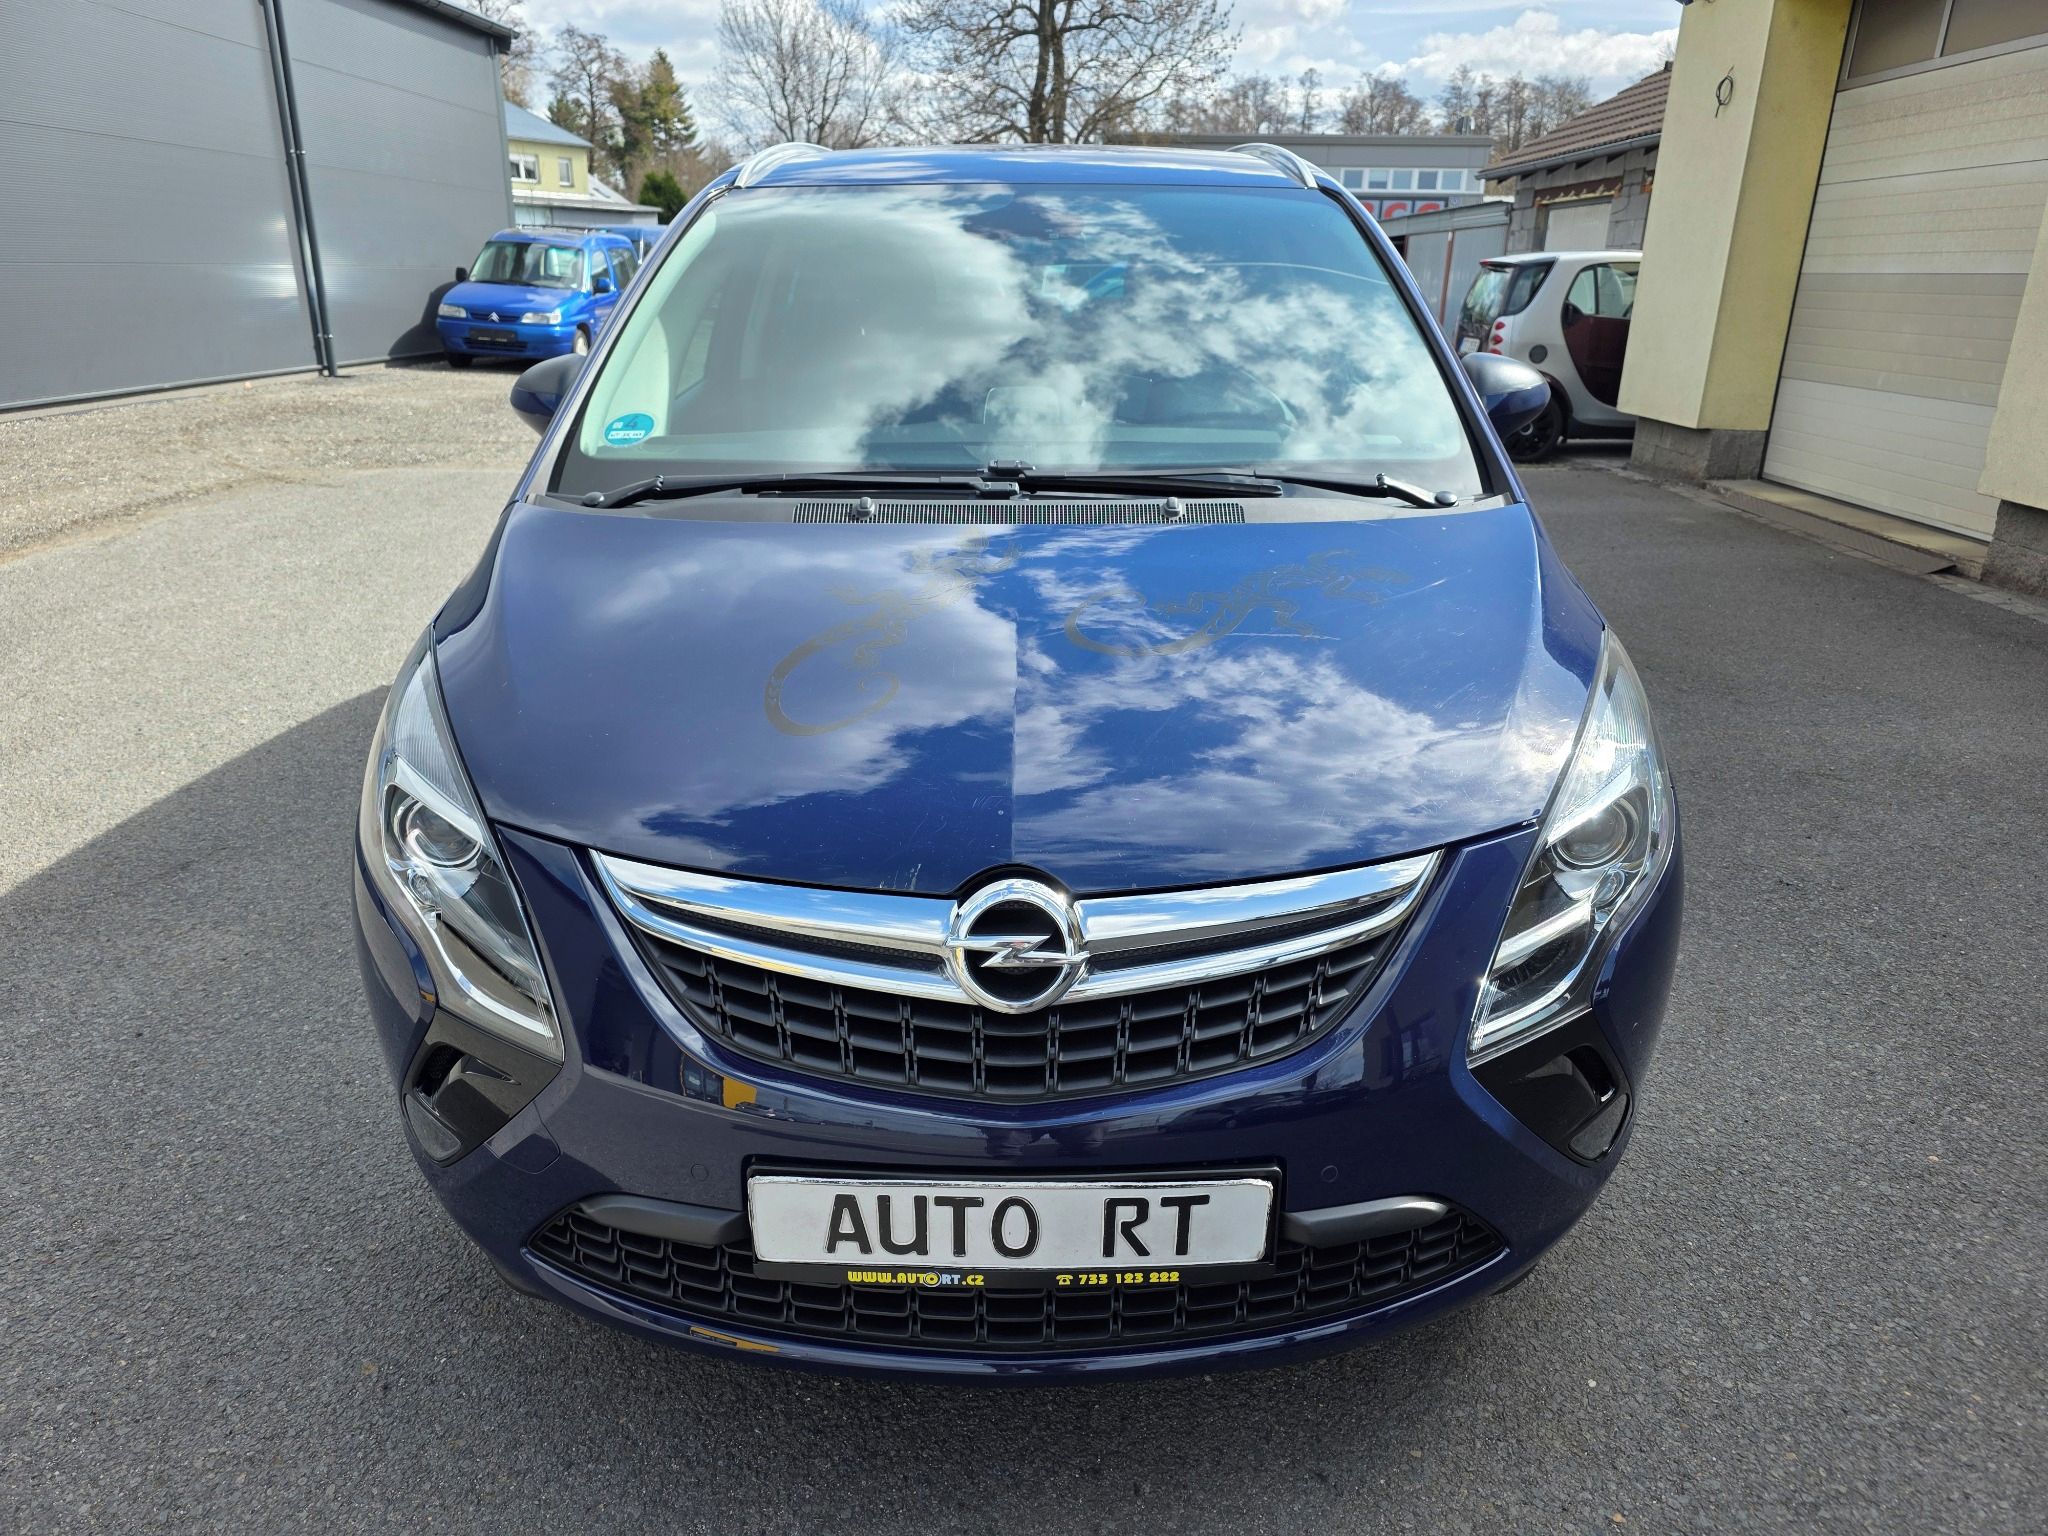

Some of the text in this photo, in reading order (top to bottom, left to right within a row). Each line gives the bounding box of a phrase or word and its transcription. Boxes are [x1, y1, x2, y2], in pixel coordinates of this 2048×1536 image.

[824, 1193, 1211, 1258] AUTO RT
[1078, 1271, 1180, 1285] 733 123 222
